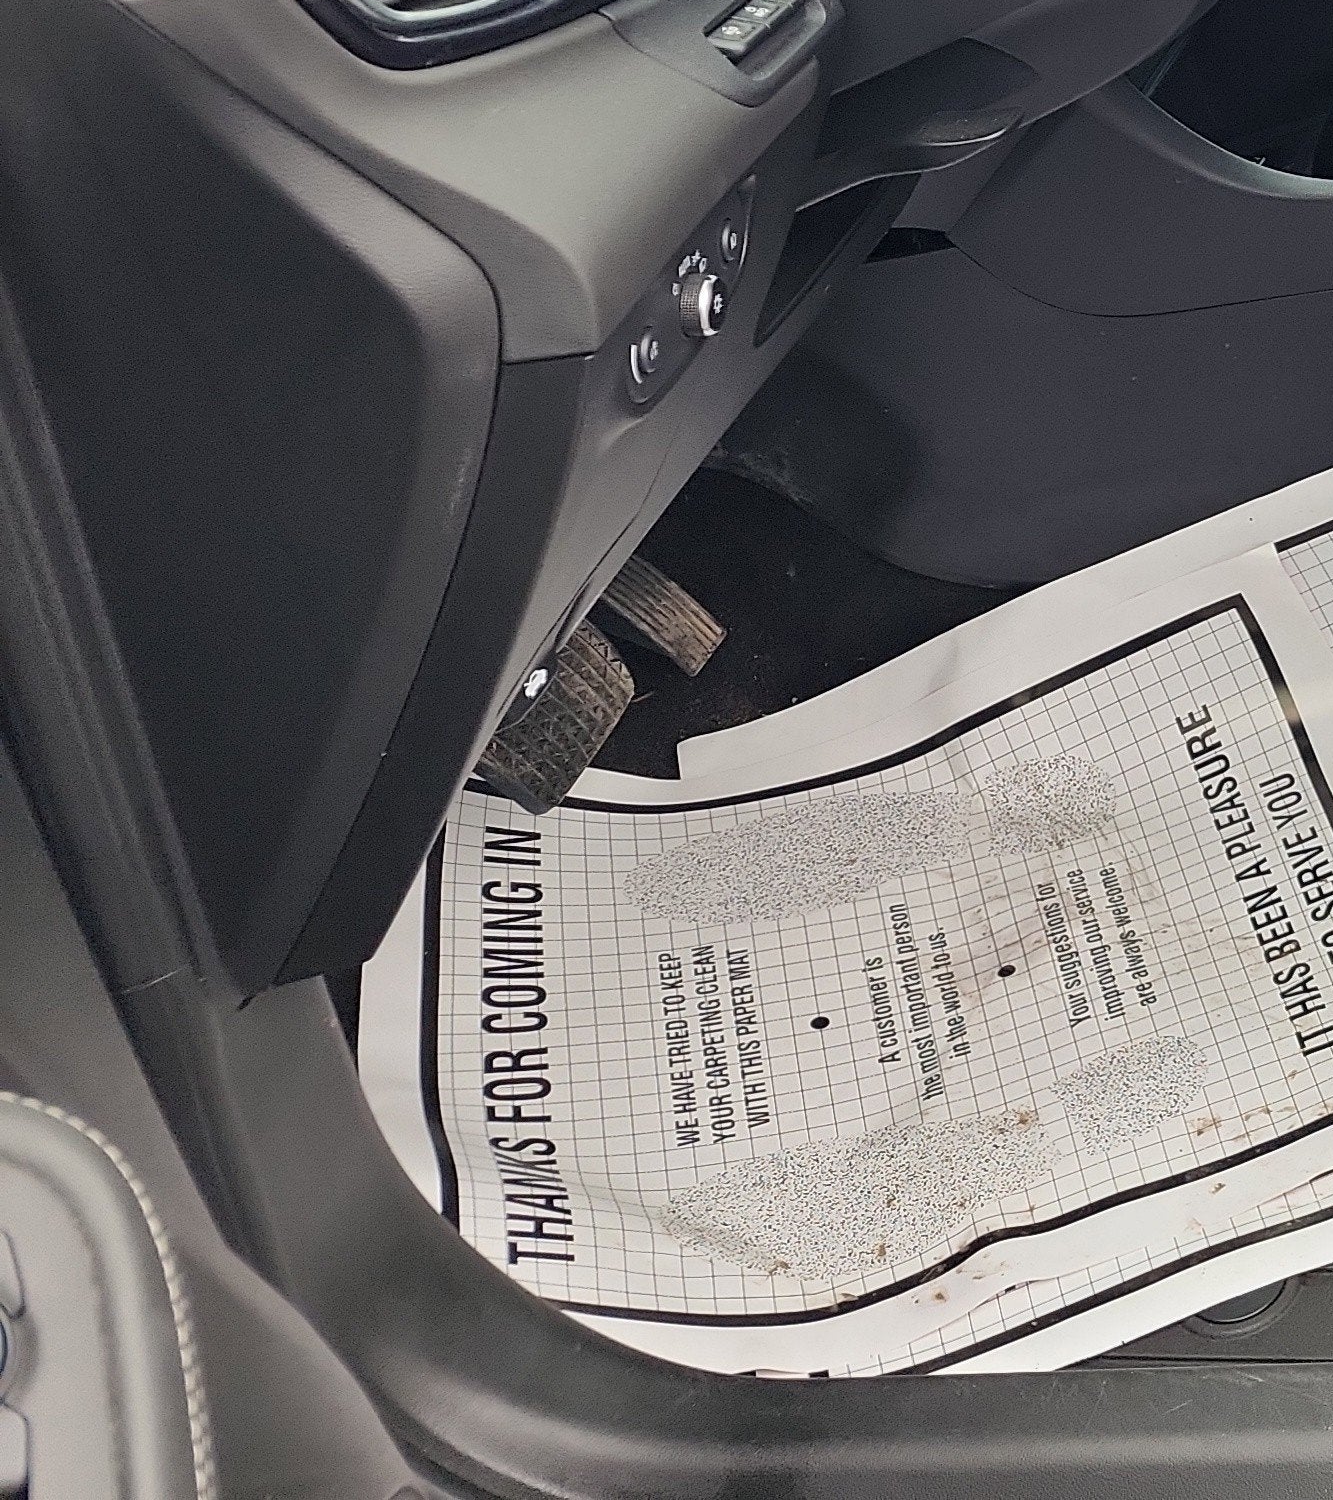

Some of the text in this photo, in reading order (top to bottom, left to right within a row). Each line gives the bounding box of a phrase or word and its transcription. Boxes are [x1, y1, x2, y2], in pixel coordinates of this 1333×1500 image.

[1175, 704, 1262, 861] PLEASURE
[1259, 773, 1308, 831] YOU
[1099, 861, 1158, 1007] are always welcome.
[1234, 857, 1273, 882] A
[1243, 885, 1302, 963] BEEN
[861, 956, 902, 1064] A customer is
[889, 903, 944, 1101] the most important person
[928, 927, 972, 1059] in the world to us.
[1035, 882, 1091, 1029] Your suggestions for
[1066, 868, 1126, 1021] improving our service
[1272, 962, 1326, 1023] HAS
[481, 826, 575, 1265] THANKS FOR COMING IN
[658, 952, 700, 1147] WE HAVE TRIED TO KEEP
[691, 945, 736, 1144] YOUR CARPETING CLEAN
[726, 948, 770, 1129] WITH THIS PAPER MAT
